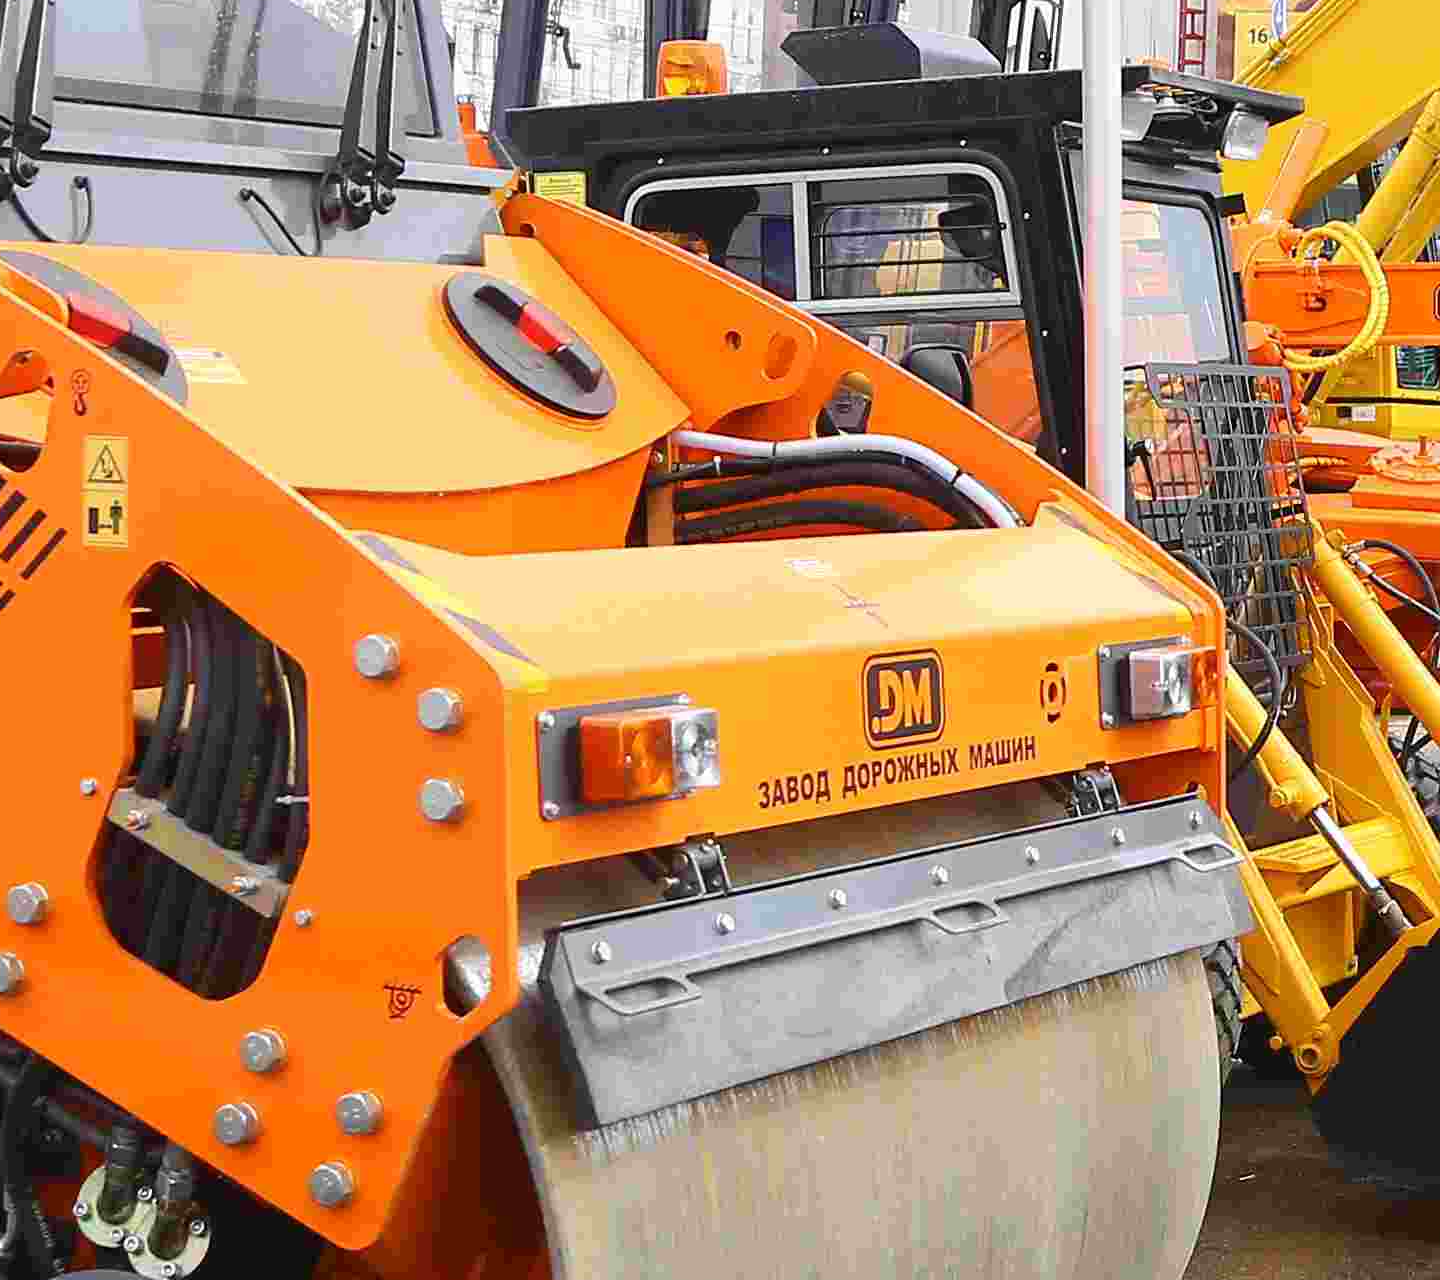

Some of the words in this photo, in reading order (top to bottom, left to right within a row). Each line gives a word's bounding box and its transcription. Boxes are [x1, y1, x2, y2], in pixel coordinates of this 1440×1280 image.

[759, 770, 831, 809] ЗАВОД
[842, 747, 959, 799] ДОРОЖНЫХ
[969, 734, 1036, 770] МАШИН
